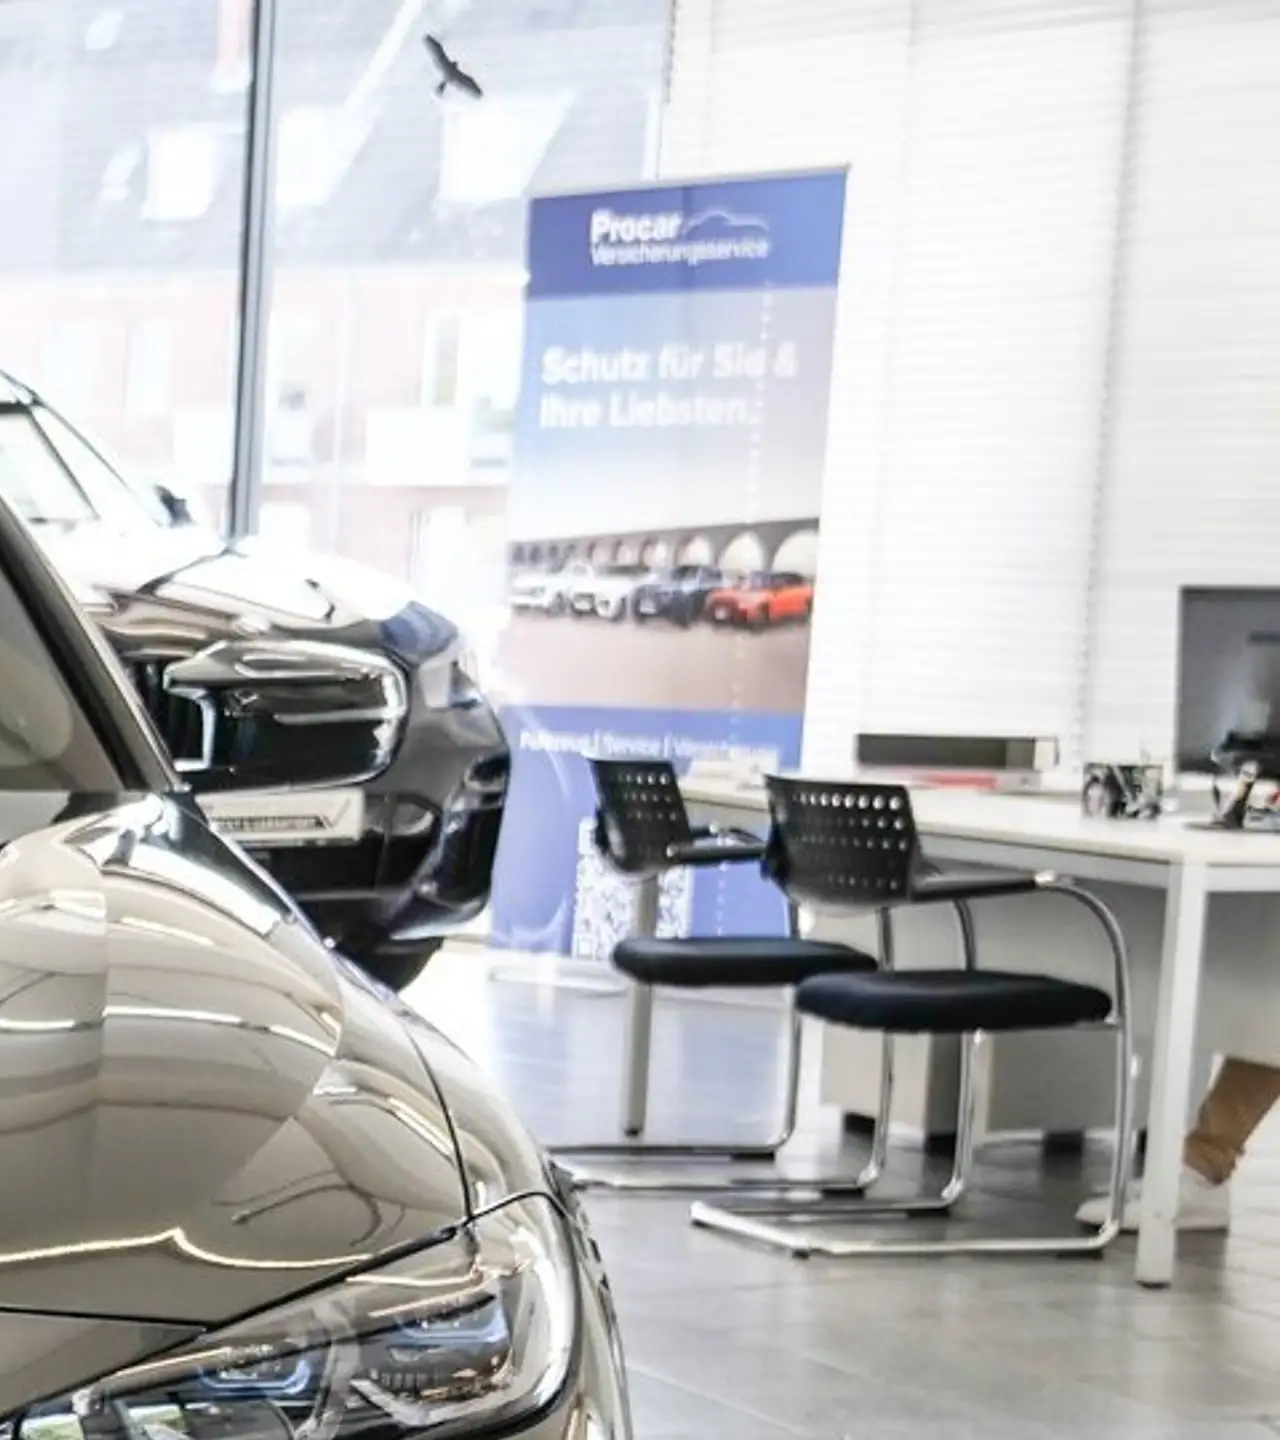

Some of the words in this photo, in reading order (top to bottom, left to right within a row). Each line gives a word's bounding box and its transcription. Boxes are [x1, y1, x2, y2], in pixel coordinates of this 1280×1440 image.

[591, 209, 681, 241] Procar
[542, 346, 648, 384] Schutz
[659, 345, 702, 381] für
[715, 343, 766, 378] Sie
[774, 342, 798, 377] &
[541, 396, 602, 429] Ihre
